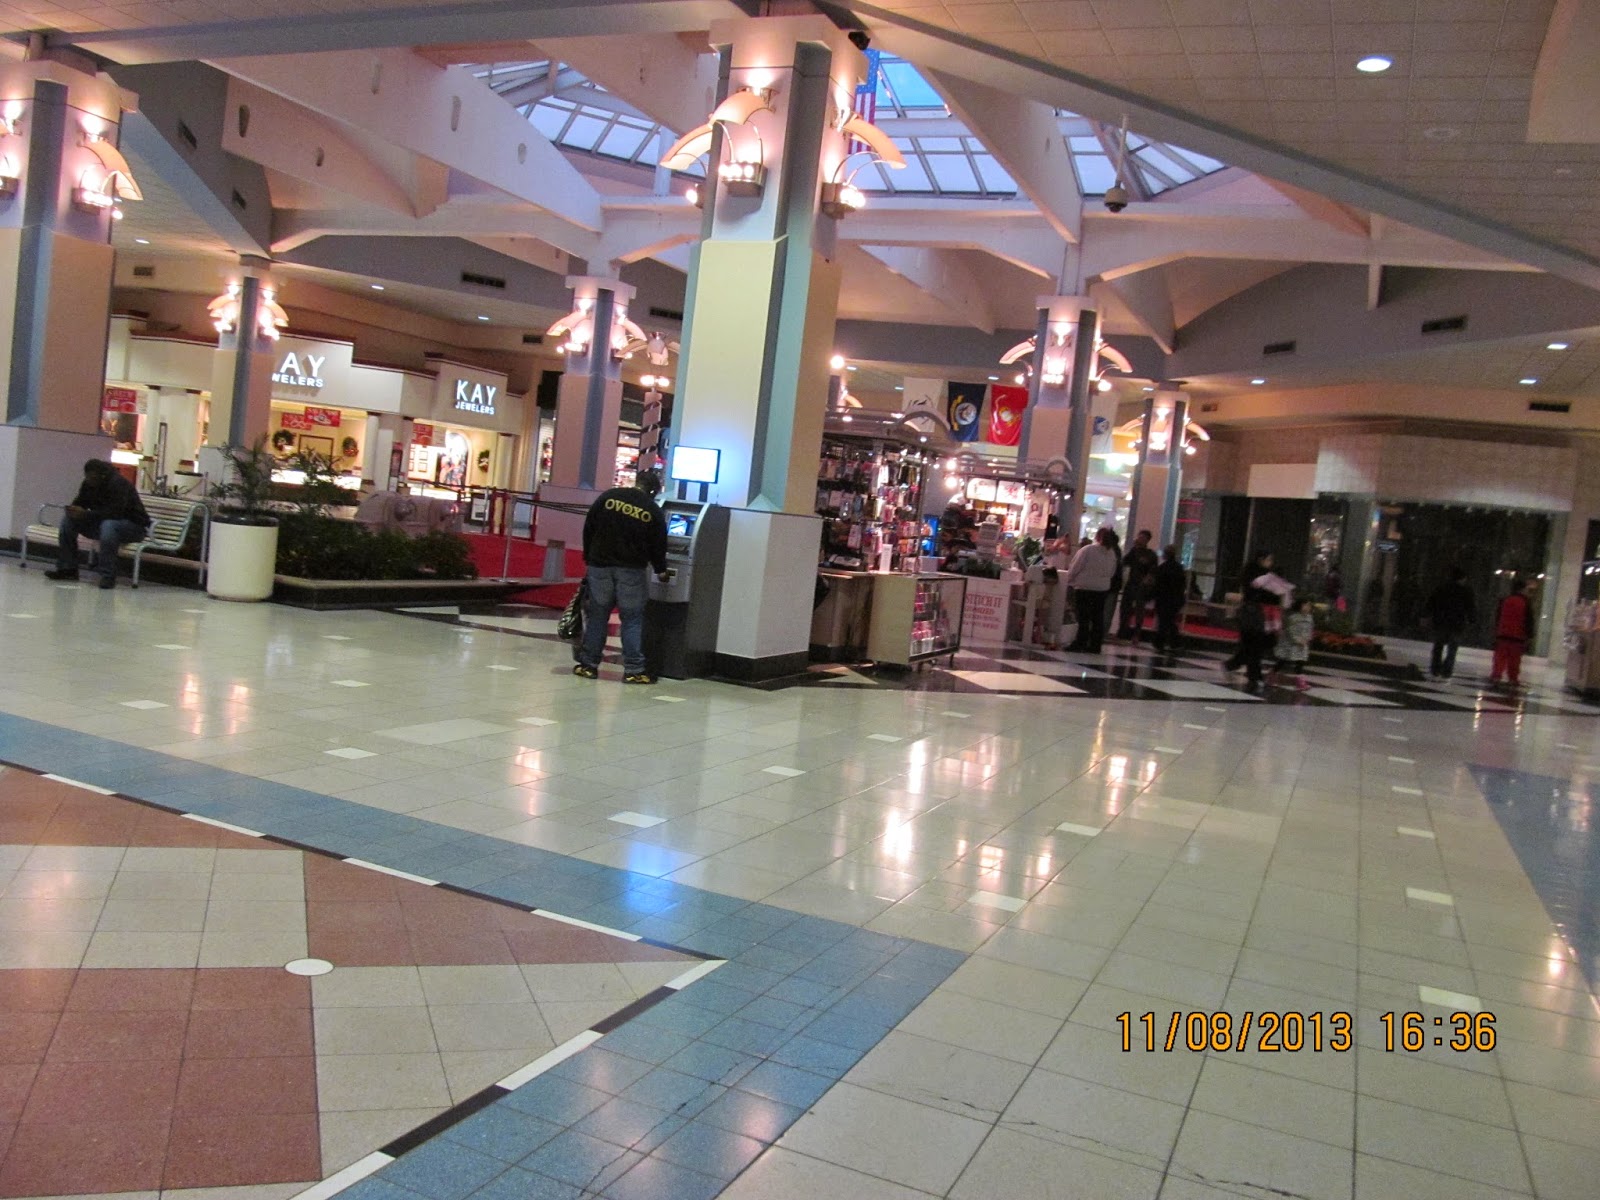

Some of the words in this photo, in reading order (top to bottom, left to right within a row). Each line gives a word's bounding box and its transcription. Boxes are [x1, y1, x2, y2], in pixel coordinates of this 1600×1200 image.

[279, 351, 326, 378] AY
[271, 372, 324, 388] WELERS
[456, 379, 497, 406] KAY
[455, 401, 495, 415] JEWELERS
[605, 498, 652, 523] OVOXO
